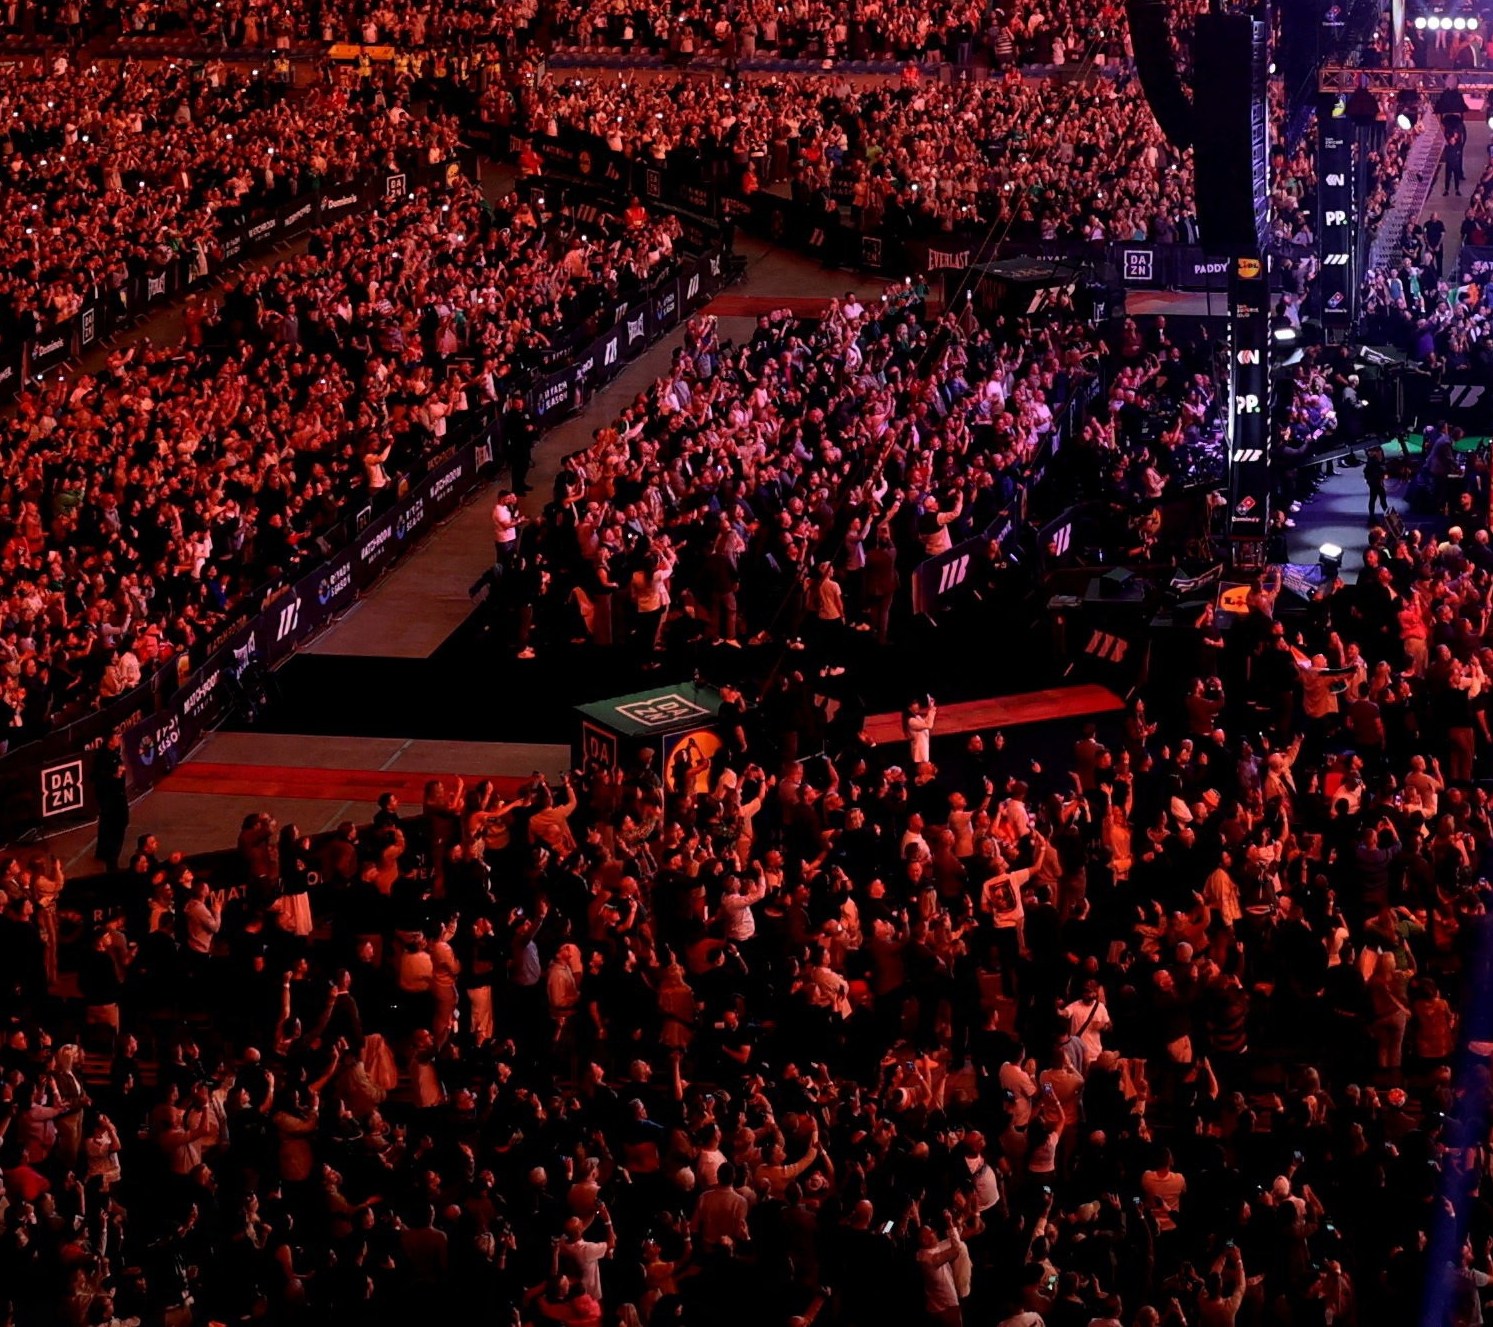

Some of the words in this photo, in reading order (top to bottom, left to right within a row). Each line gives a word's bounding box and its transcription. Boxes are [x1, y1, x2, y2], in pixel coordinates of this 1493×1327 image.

[928, 248, 970, 271] EVERLAST
[1130, 255, 1147, 265] DA
[1130, 265, 1147, 275] ZN
[590, 736, 609, 764] DA
[51, 769, 74, 791] DA
[51, 788, 75, 808] ZN
